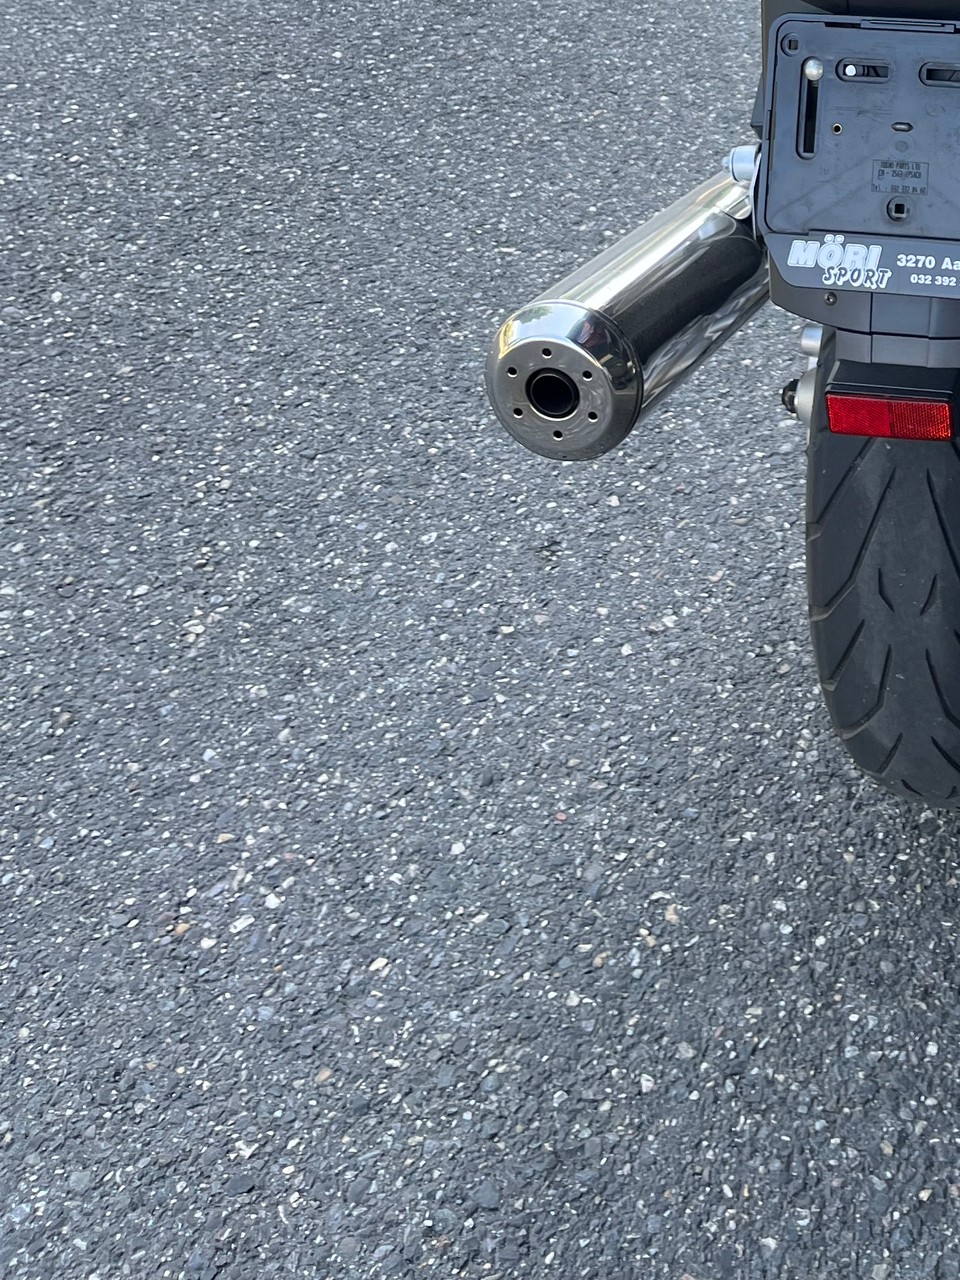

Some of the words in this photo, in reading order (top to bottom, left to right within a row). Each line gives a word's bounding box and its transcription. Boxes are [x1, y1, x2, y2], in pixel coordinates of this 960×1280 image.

[787, 234, 882, 270] MÖRI
[896, 253, 936, 269] 3270
[822, 266, 892, 289] SPORT
[910, 274, 932, 285] 032
[934, 275, 957, 287] 392
